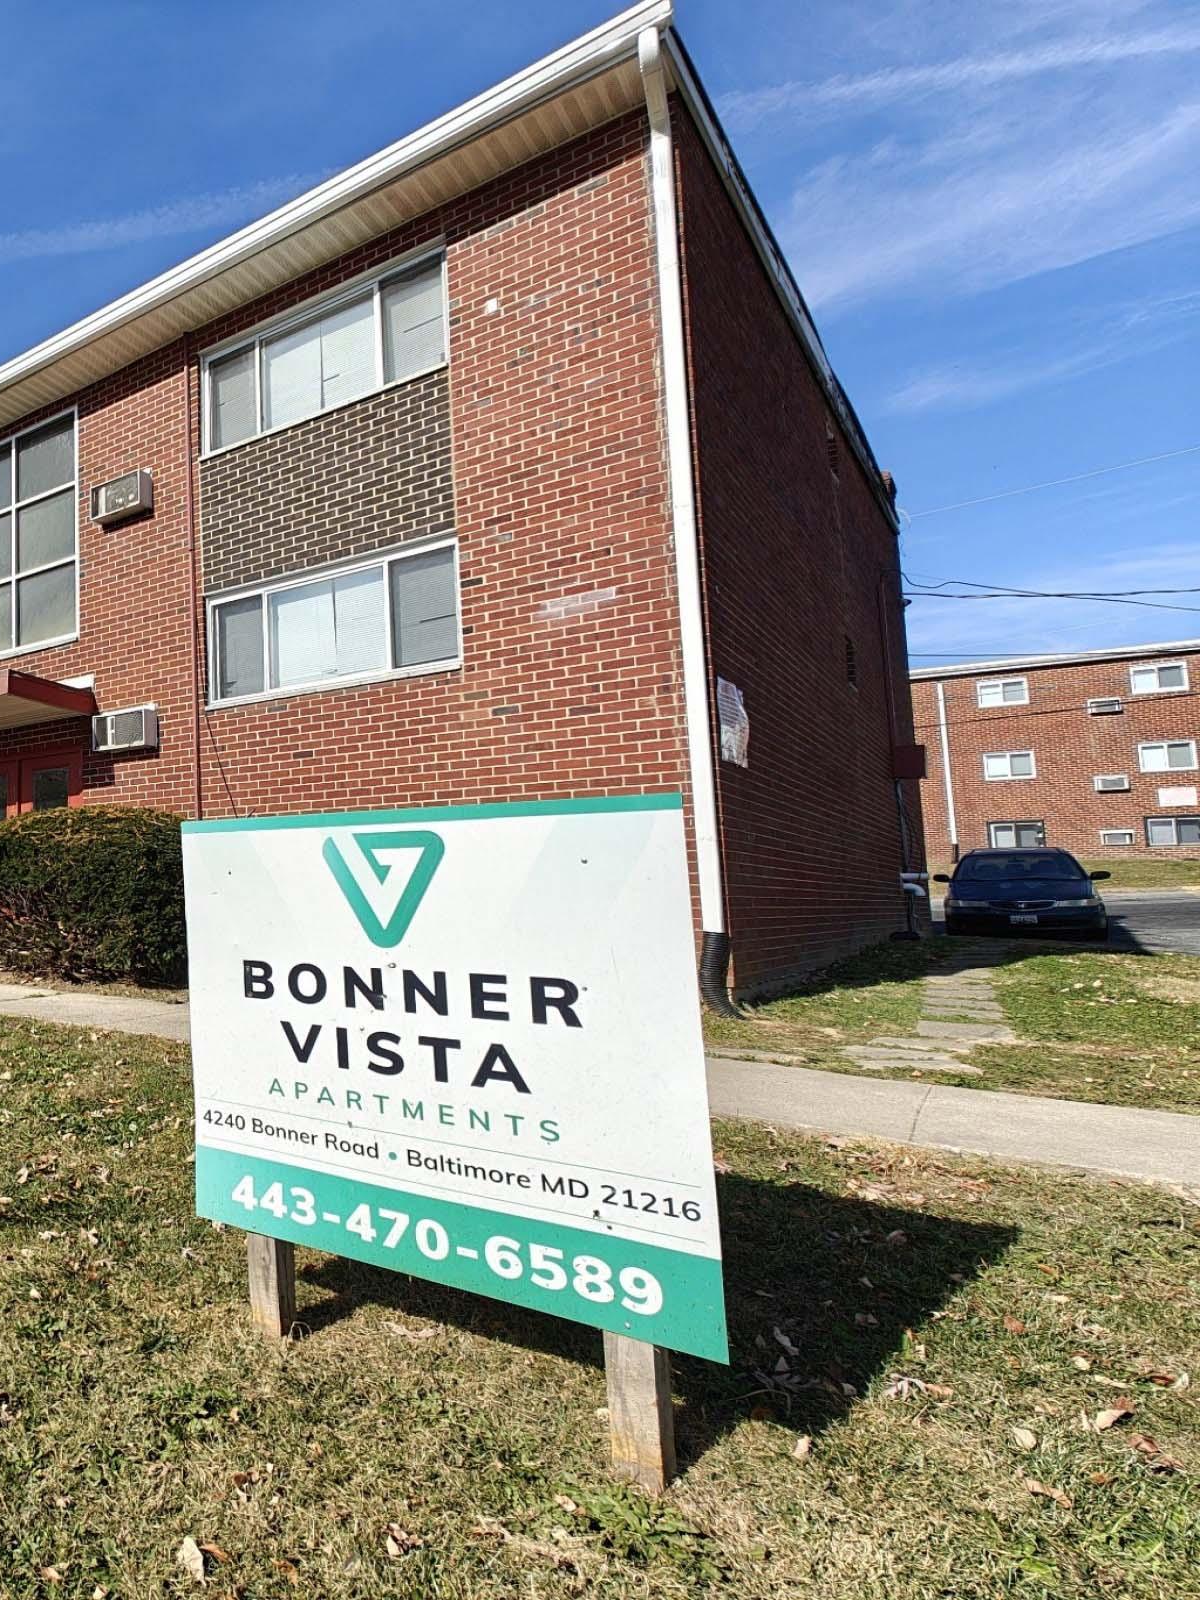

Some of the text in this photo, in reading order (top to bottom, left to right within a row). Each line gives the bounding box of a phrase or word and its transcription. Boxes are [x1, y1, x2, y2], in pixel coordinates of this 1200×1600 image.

[243, 960, 584, 1028] BONNER
[280, 1020, 532, 1095] VISTA
[268, 1078, 561, 1143] APARTMENTS
[203, 1109, 702, 1222] 4240 Bonner Road Baltimore MD 21216
[231, 1175, 664, 1316] 443-470-6589
